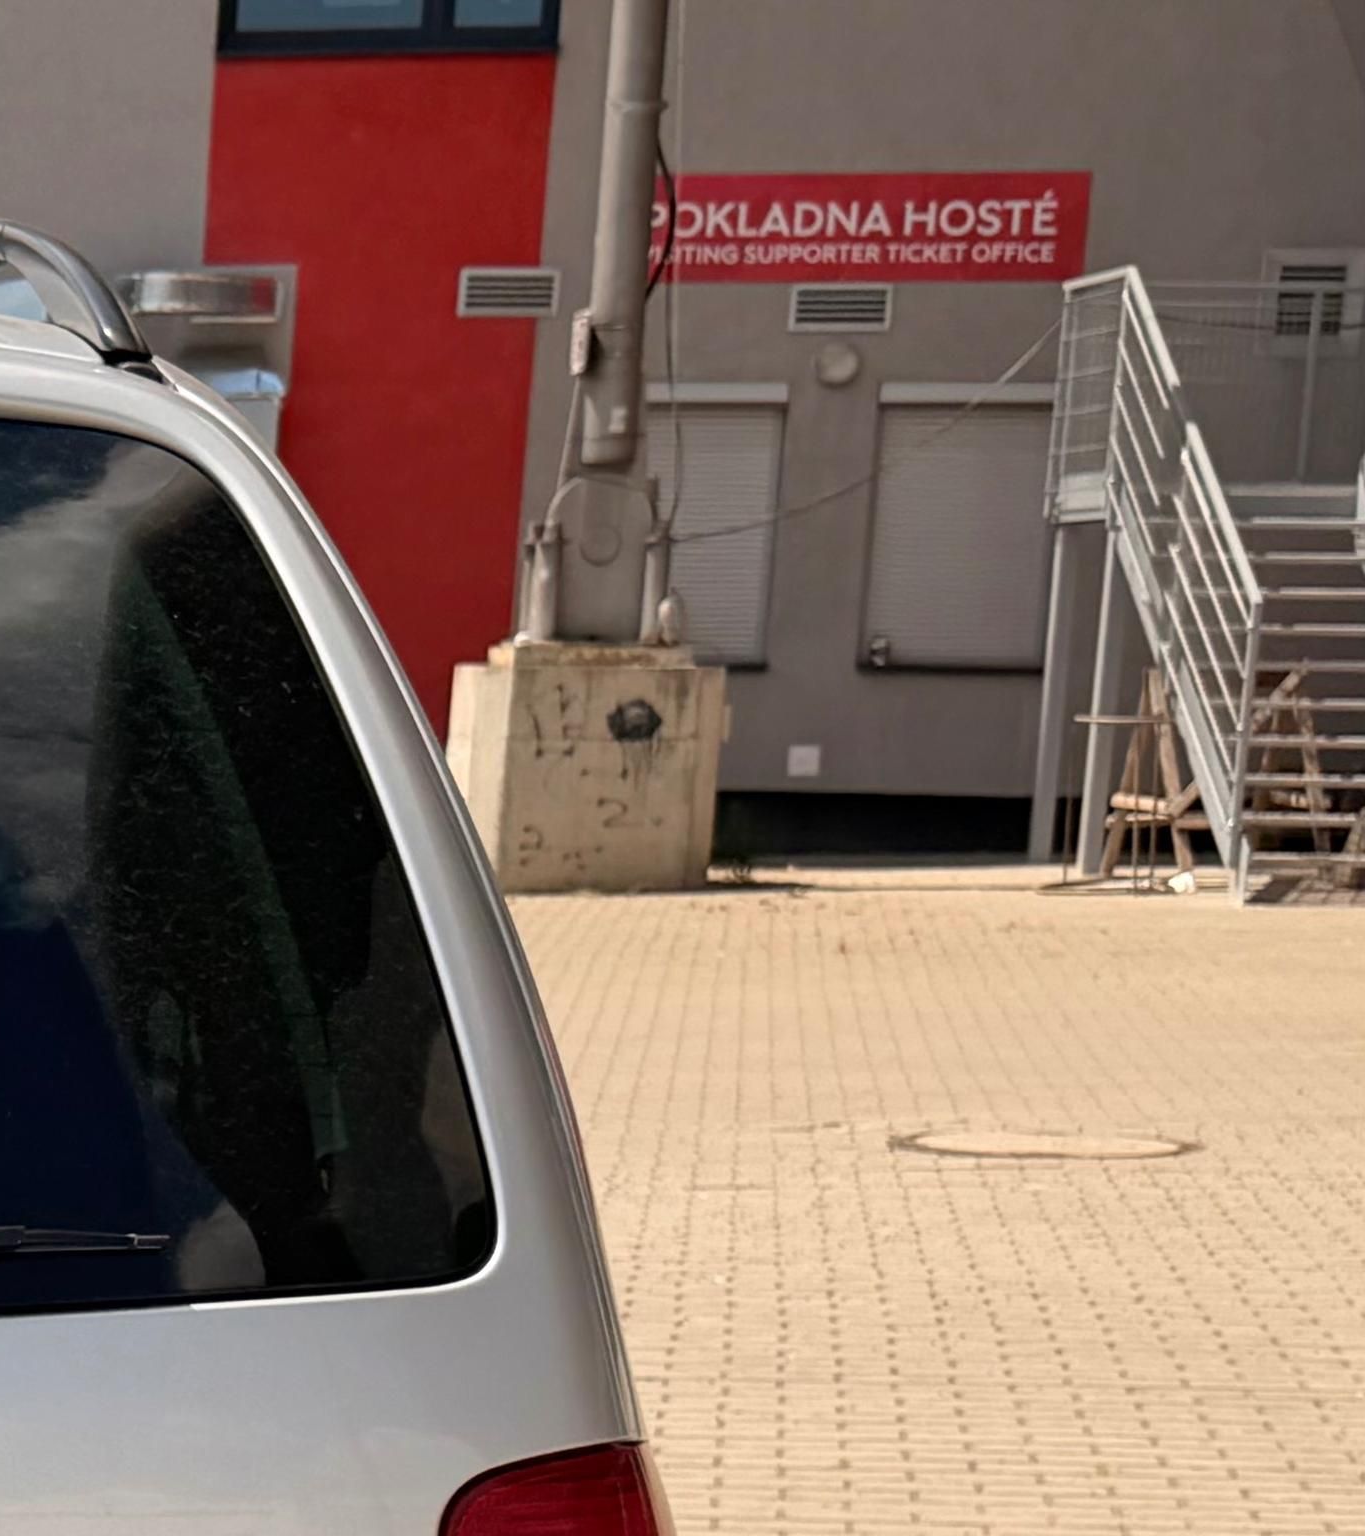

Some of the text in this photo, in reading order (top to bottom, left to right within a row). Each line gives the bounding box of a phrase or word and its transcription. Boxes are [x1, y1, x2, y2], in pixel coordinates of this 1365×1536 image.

[903, 188, 1059, 237] HOSTÉ
[743, 242, 881, 264] SUPPORTER
[886, 241, 969, 263] TICKET
[971, 241, 1056, 263] OFFICE
